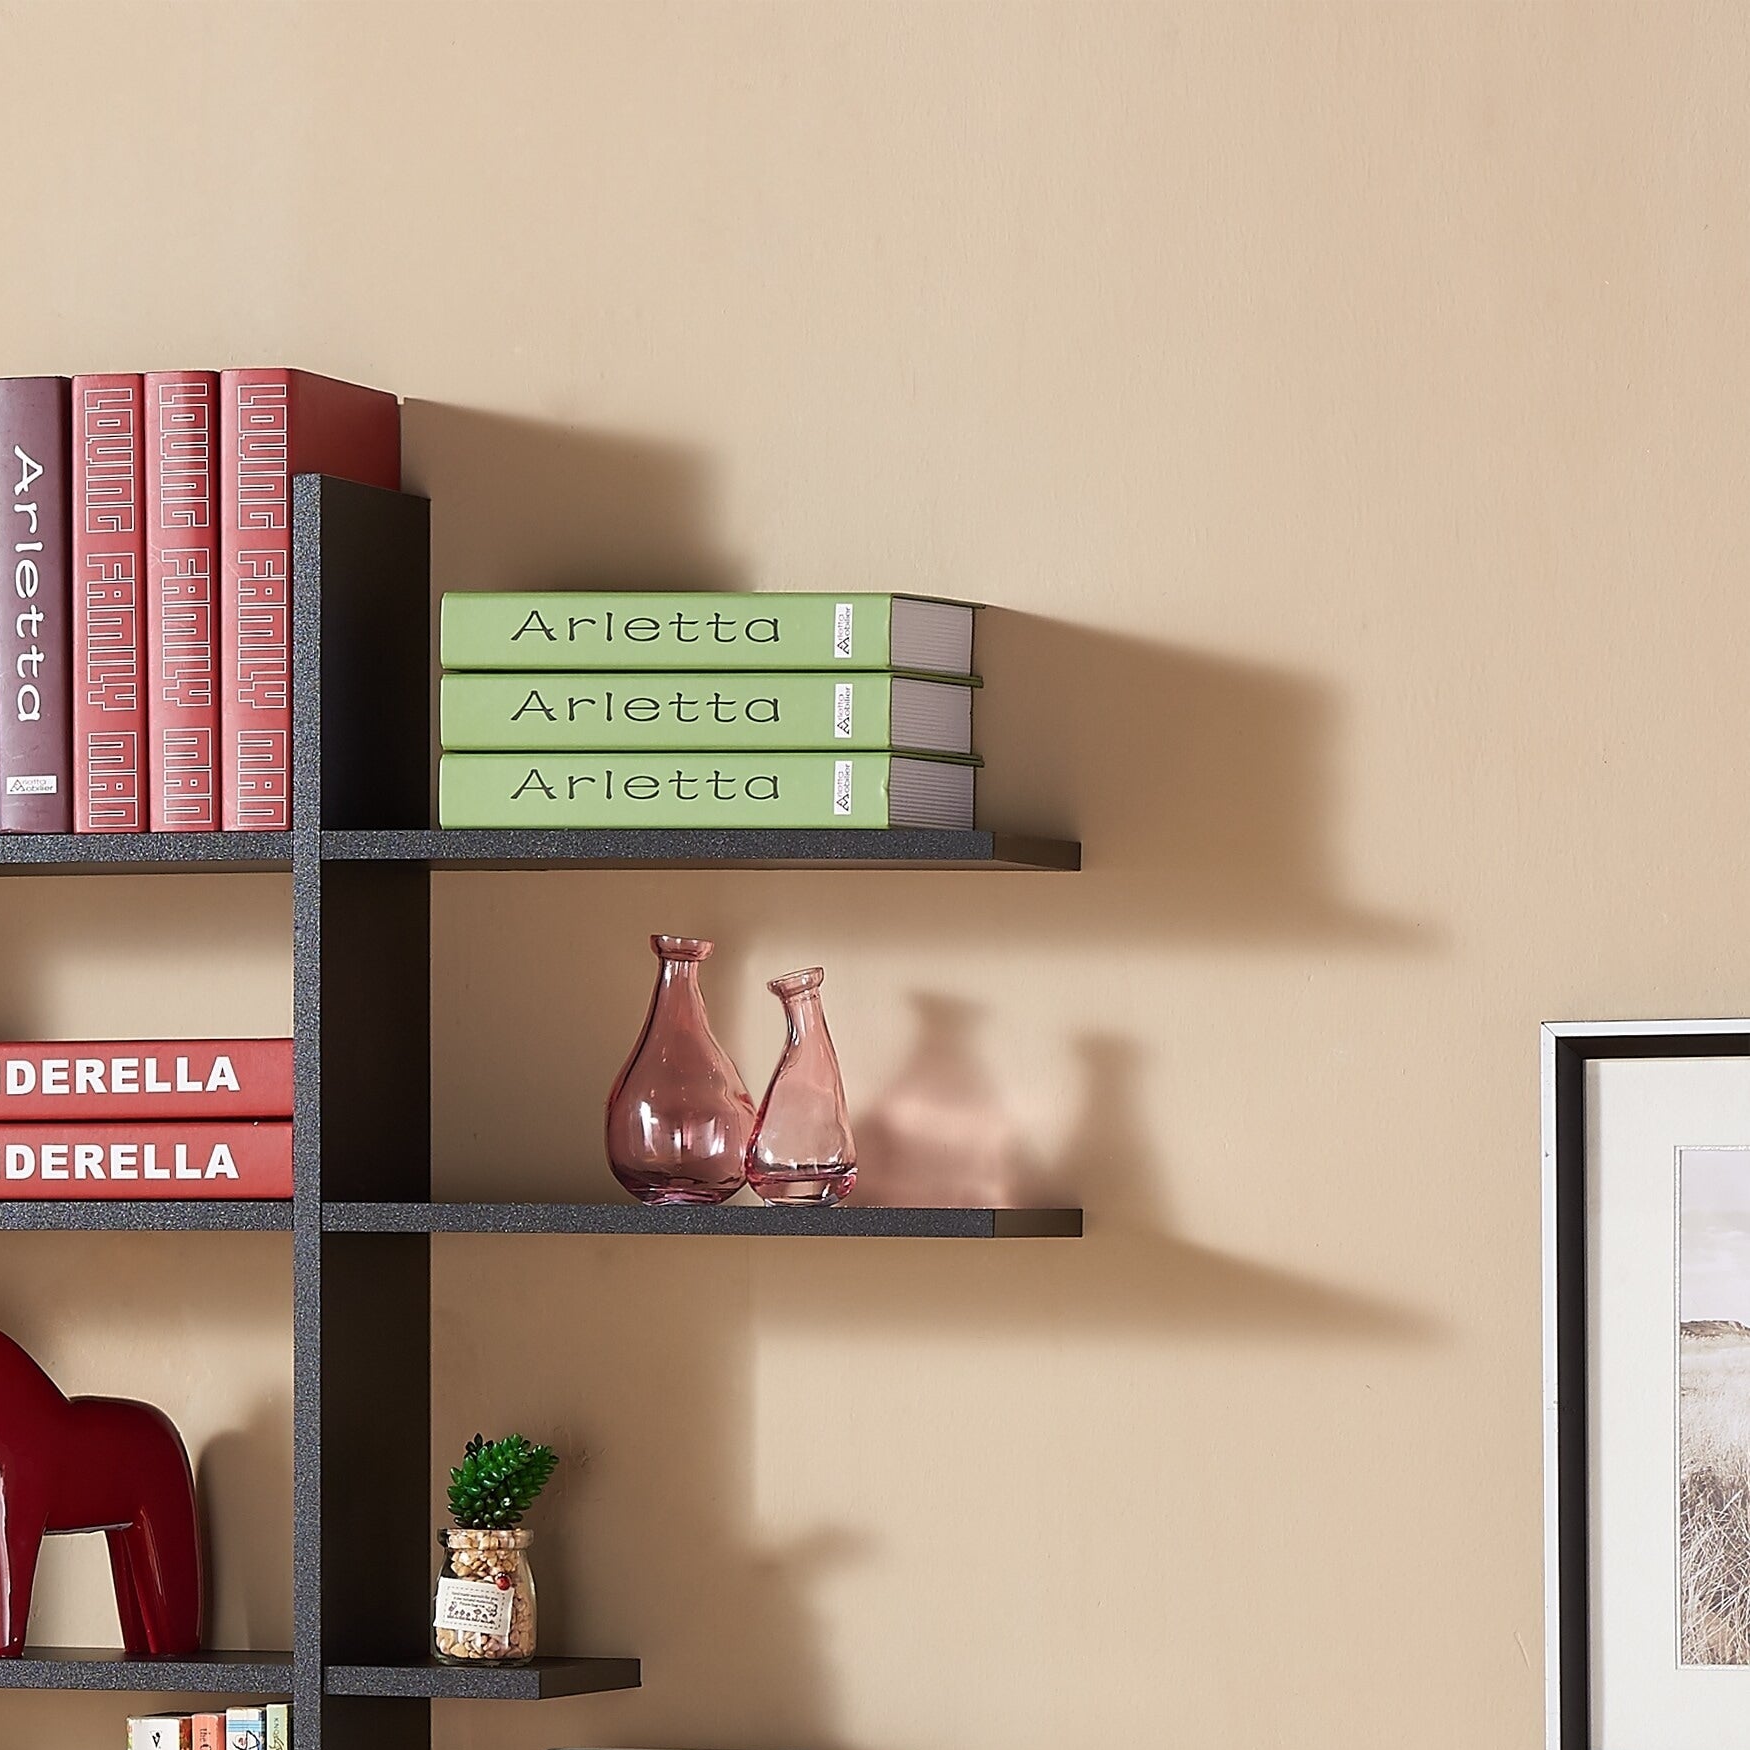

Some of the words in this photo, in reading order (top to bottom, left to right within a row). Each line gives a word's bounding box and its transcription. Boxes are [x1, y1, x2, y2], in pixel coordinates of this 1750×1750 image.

[14, 445, 46, 723] Arletta
[87, 553, 137, 711] FAMILY
[161, 549, 211, 708] FAMILY
[238, 550, 287, 709] FAMILY
[510, 609, 782, 643] Arletta
[510, 690, 782, 723] Arletta
[88, 732, 138, 827] MAN
[164, 728, 212, 824] MAN
[238, 731, 287, 827] MAN
[510, 768, 782, 801] Arletta
